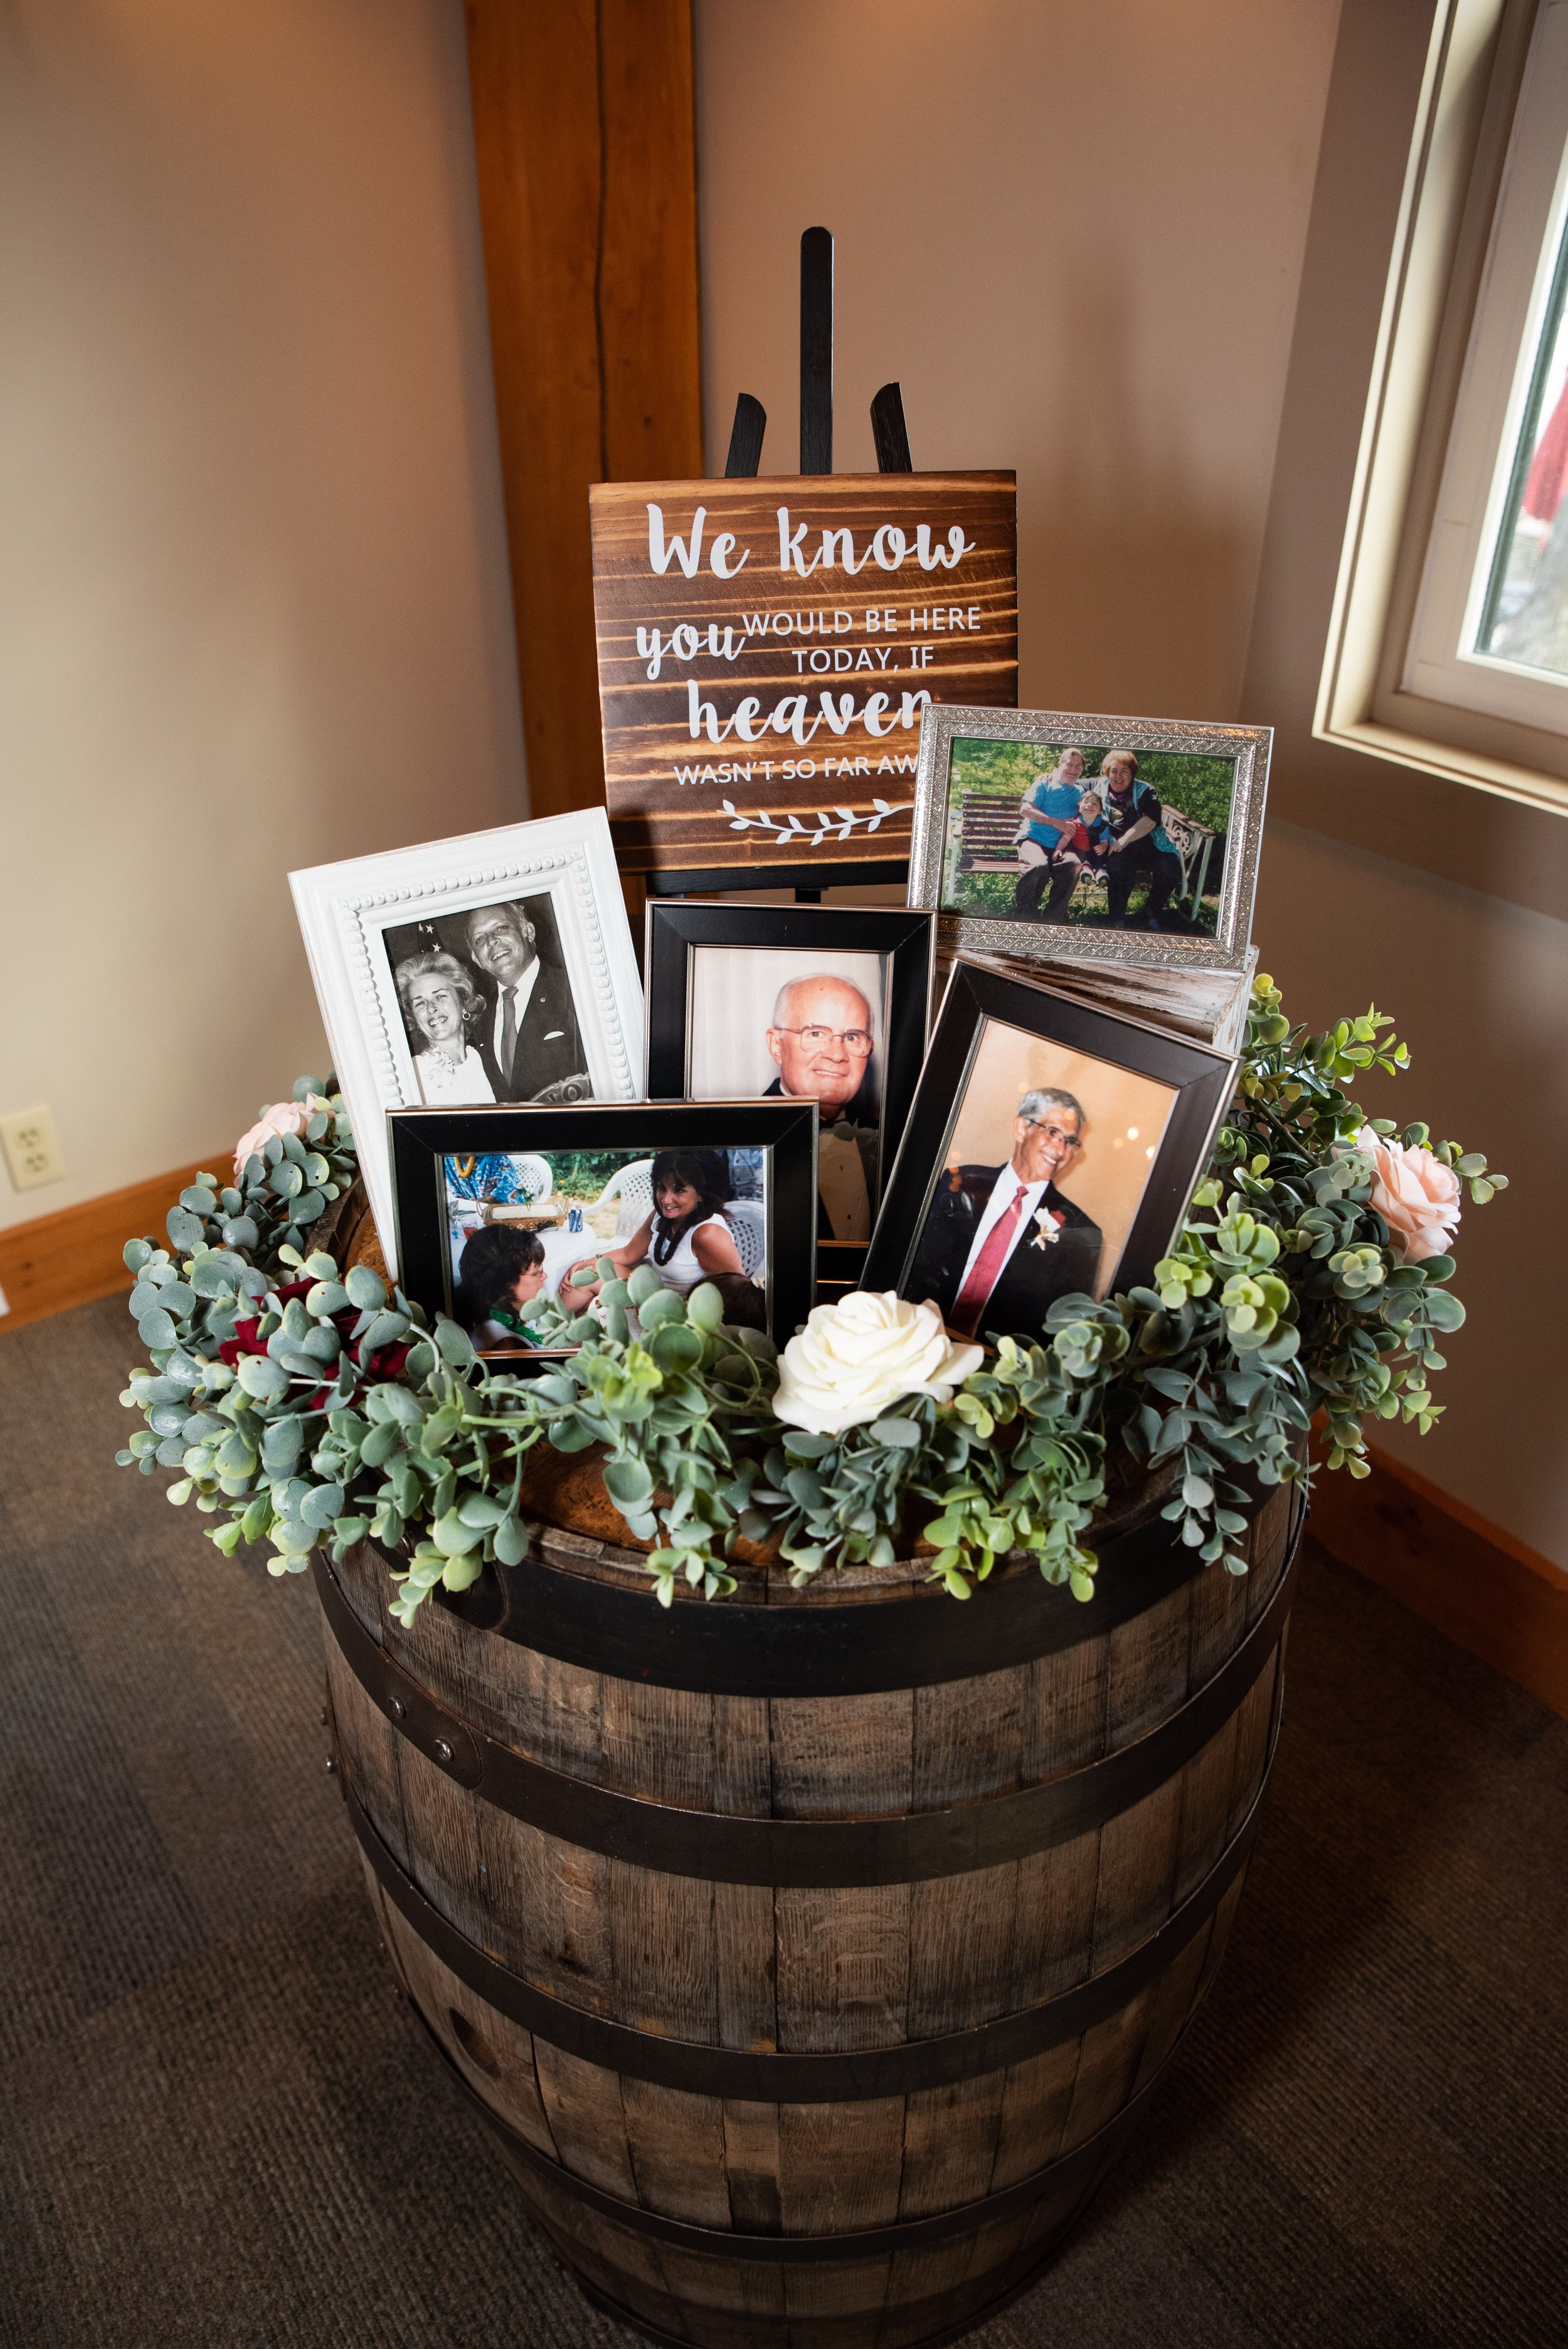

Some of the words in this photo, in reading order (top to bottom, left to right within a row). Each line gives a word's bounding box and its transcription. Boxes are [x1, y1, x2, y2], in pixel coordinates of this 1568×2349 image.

[647, 504, 750, 579] We
[777, 507, 976, 578] know
[636, 623, 746, 680] you
[743, 612, 852, 636] WOULD
[865, 609, 898, 633] BE
[909, 607, 981, 631] HERE
[792, 648, 899, 673] TODAY,
[911, 646, 934, 669] IF
[687, 679, 933, 745] heaven
[673, 761, 775, 785] WASN'T
[782, 759, 817, 780] SO
[825, 756, 871, 778] FAR
[877, 754, 918, 775] AW
